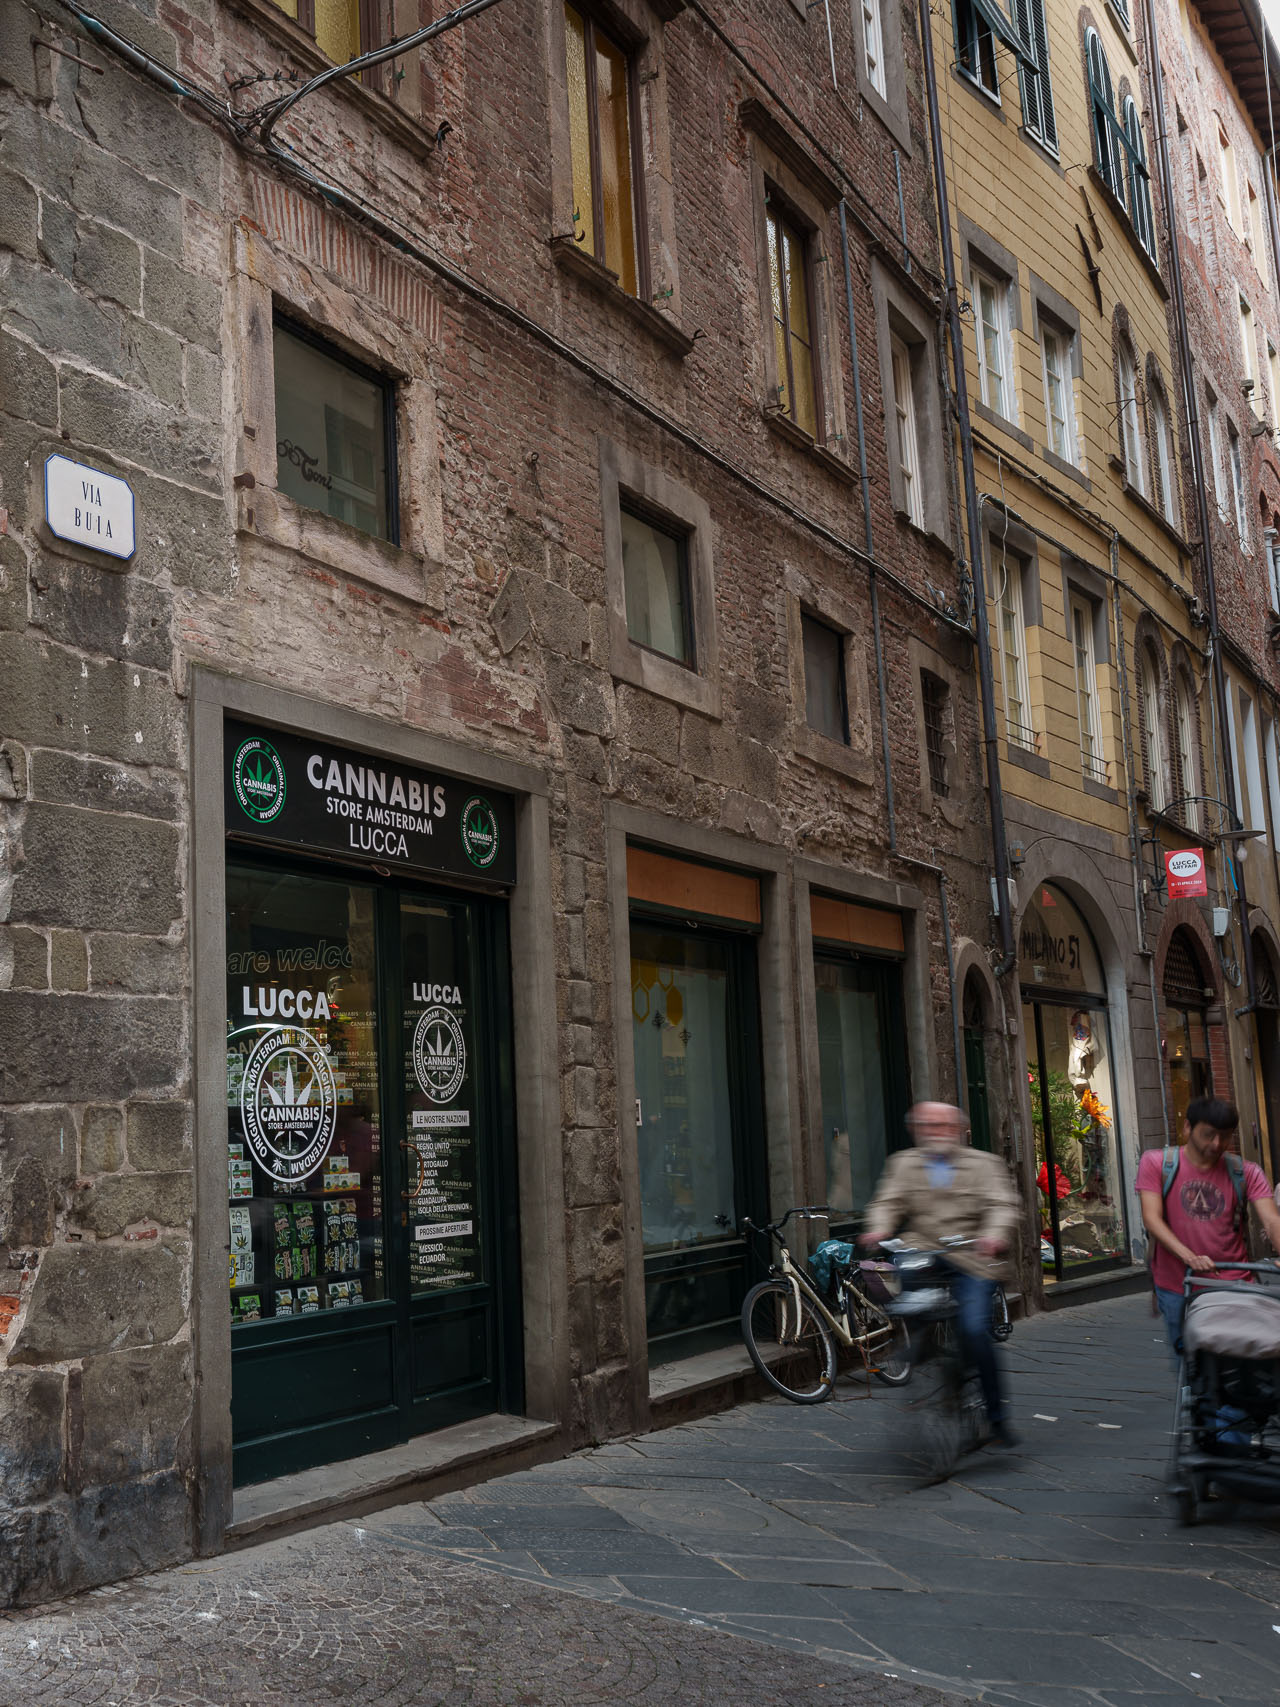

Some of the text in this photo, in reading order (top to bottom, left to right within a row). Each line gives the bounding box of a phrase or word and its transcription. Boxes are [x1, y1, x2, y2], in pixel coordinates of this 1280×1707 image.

[82, 480, 102, 506] VIA
[74, 507, 112, 538] BUIA
[235, 741, 260, 806] ORIGINAL AMSTERDAM
[243, 777, 277, 793] CANNABIS
[259, 755, 284, 819] ORIGINAL AMSTERDAM
[306, 754, 446, 818] CANNABIS
[326, 796, 433, 835] STORE AMSTERDAM
[349, 823, 409, 858] LUCCA
[468, 830, 492, 842] CANNABIS
[1023, 930, 1080, 969] MILANO 51
[227, 950, 270, 975] are
[412, 982, 462, 1005] LUCCA
[242, 986, 331, 1020] LUCCA
[416, 1010, 440, 1087] ORIGINAL AMSTERDAM
[423, 1056, 456, 1066] CANNABIS
[440, 1023, 463, 1099] ORIGINAL AMSTERDAM
[246, 1033, 290, 1158] ORIGINAL AMSTERDAM
[260, 1107, 320, 1122] CANNABIS
[290, 1052, 333, 1174] ORIGINAL AMSTERDAM
[416, 1114, 468, 1124] LE NOSTRE NAZIONI
[268, 1122, 283, 1130] STORE
[416, 1134, 432, 1142] ITALIA
[434, 1142, 450, 1150] UNITO
[417, 1152, 436, 1160] AGNA
[417, 1160, 449, 1169] PRTOGALLO
[417, 1170, 438, 1178] FANCIA
[441, 1180, 472, 1188] CANNABIS
[417, 1196, 447, 1205] GUADALUPA
[417, 1206, 432, 1214] ISOLA
[433, 1205, 447, 1213] DELLA
[420, 1223, 469, 1236] PROSSIME APERTURE
[418, 1242, 444, 1253] MESSICO
[419, 1253, 446, 1264] ECUADOR
